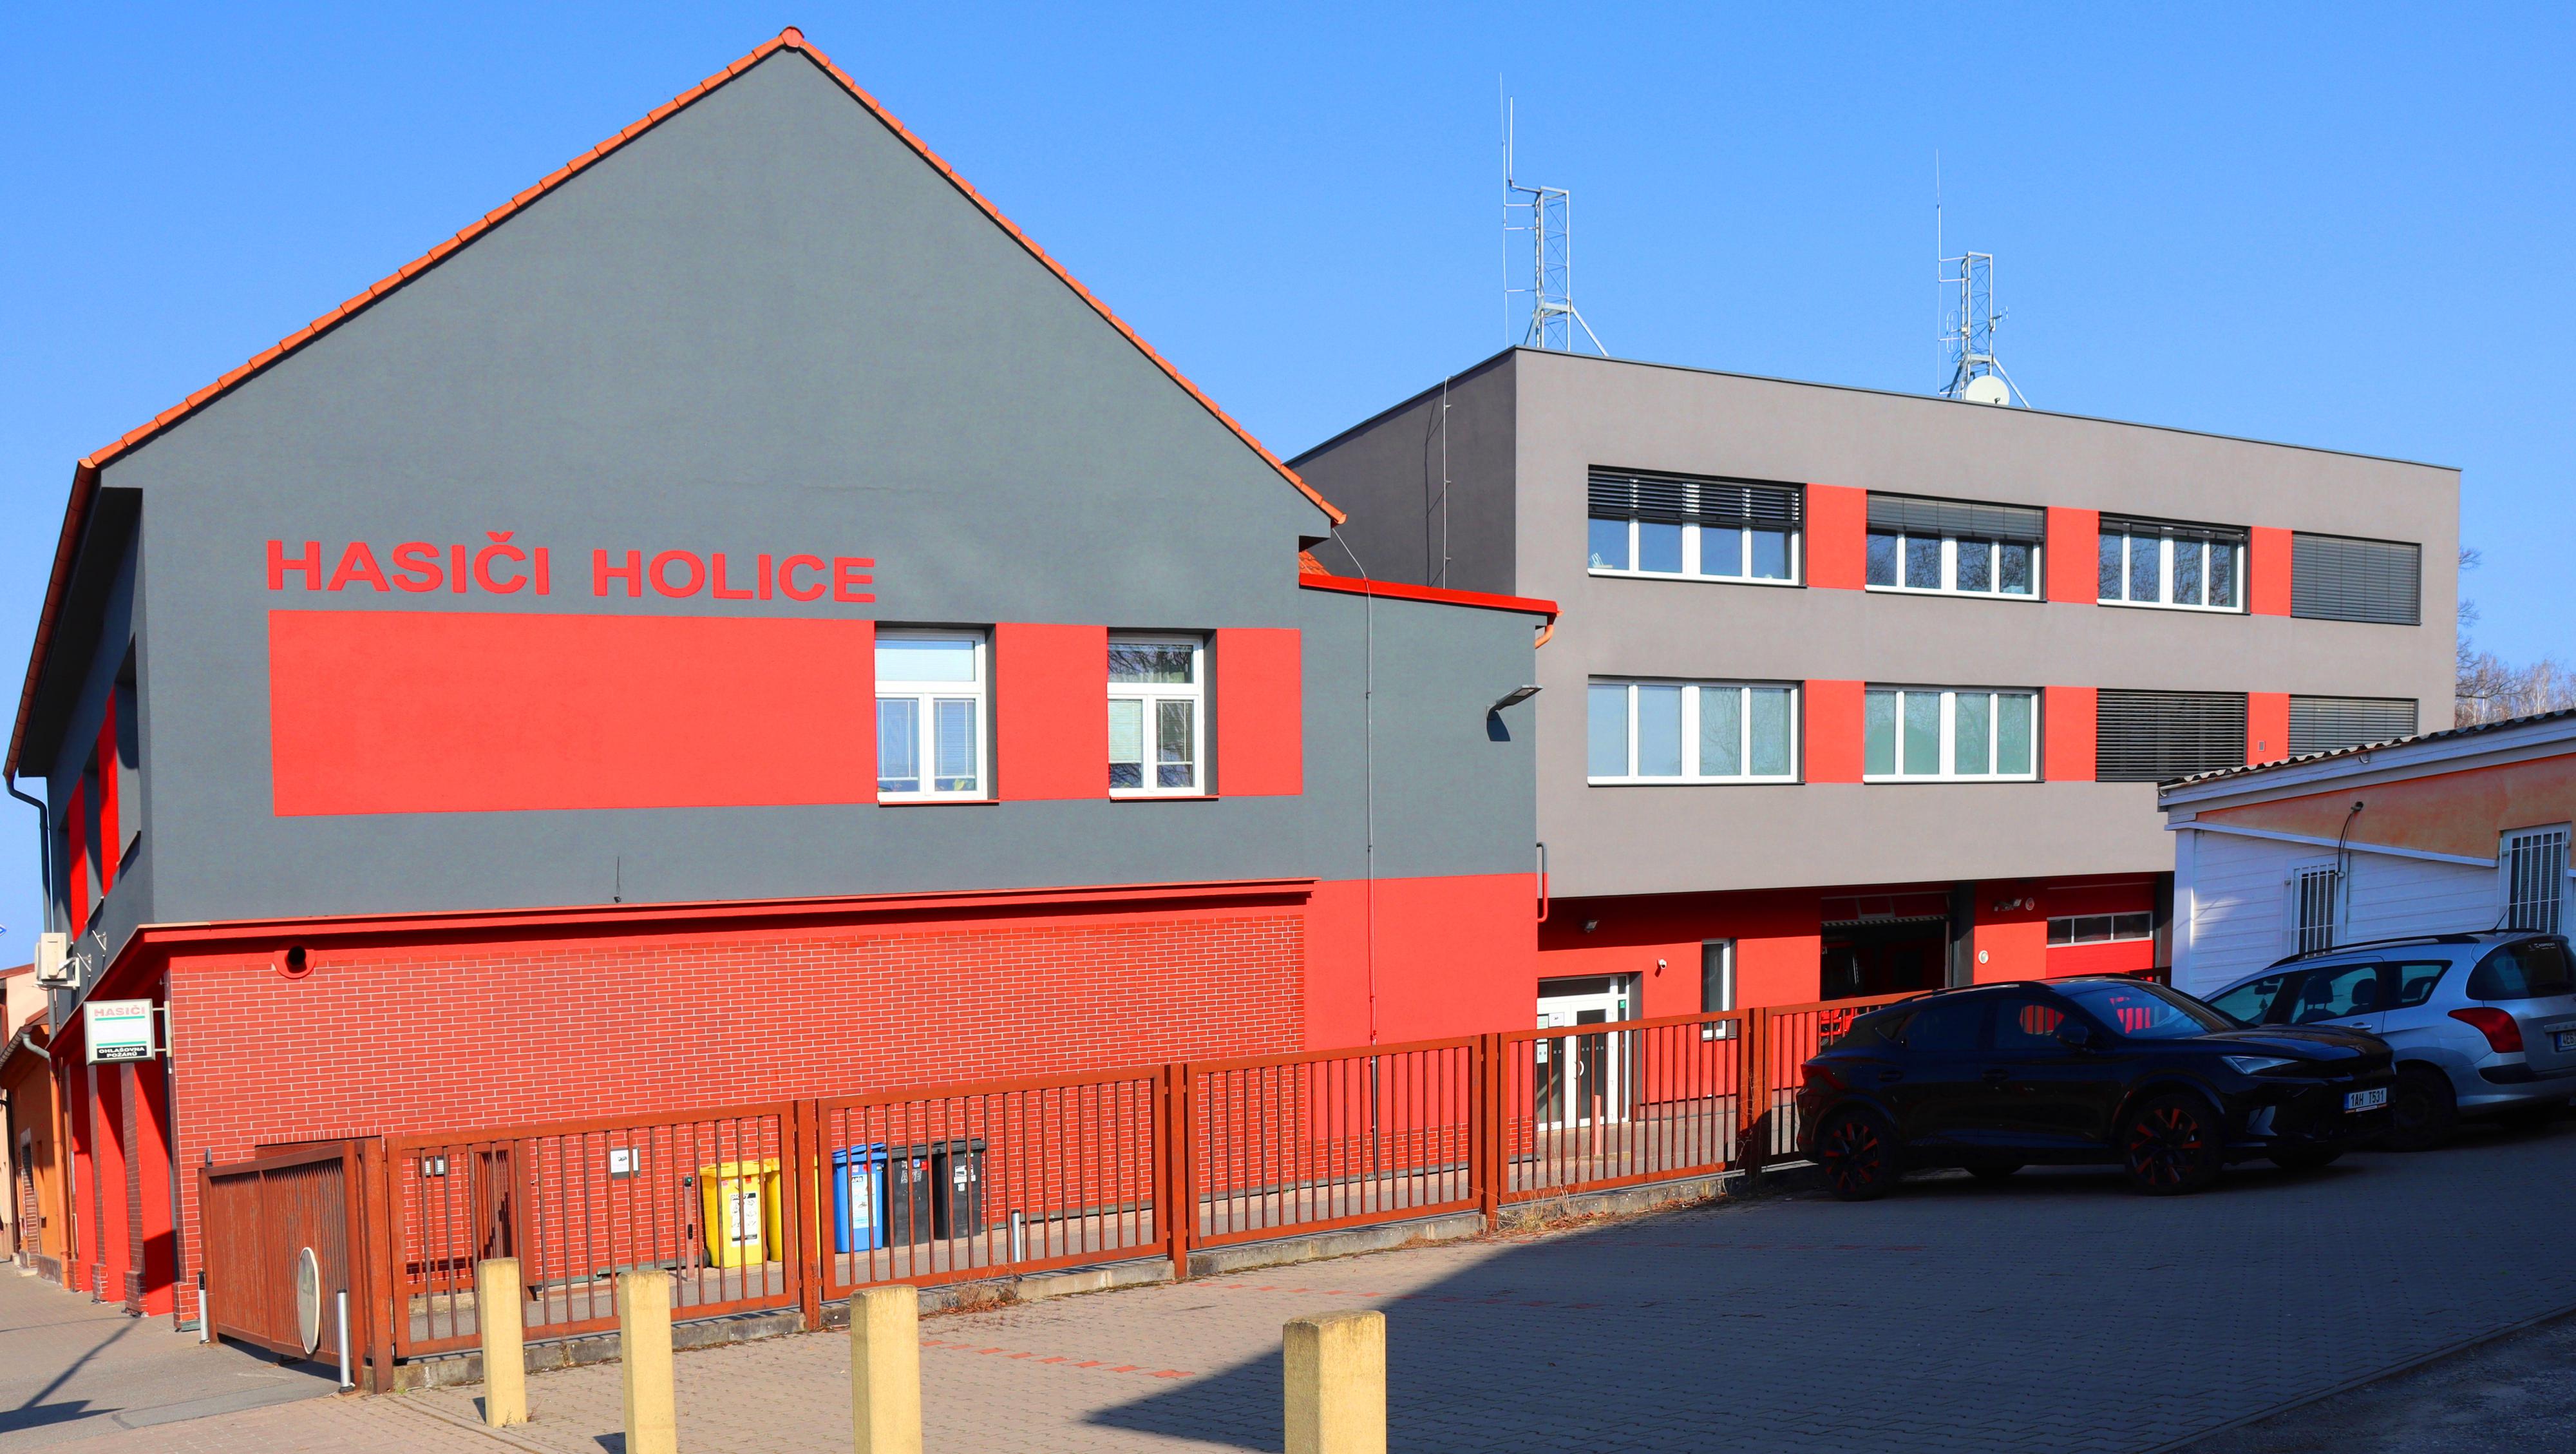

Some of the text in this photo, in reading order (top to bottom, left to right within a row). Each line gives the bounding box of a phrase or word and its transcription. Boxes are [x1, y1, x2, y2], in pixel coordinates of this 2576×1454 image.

[267, 531, 876, 603] HASIČI HOLICE
[94, 1005, 145, 1017] HASIČI
[2351, 1089, 2384, 1107] 1AH T531
